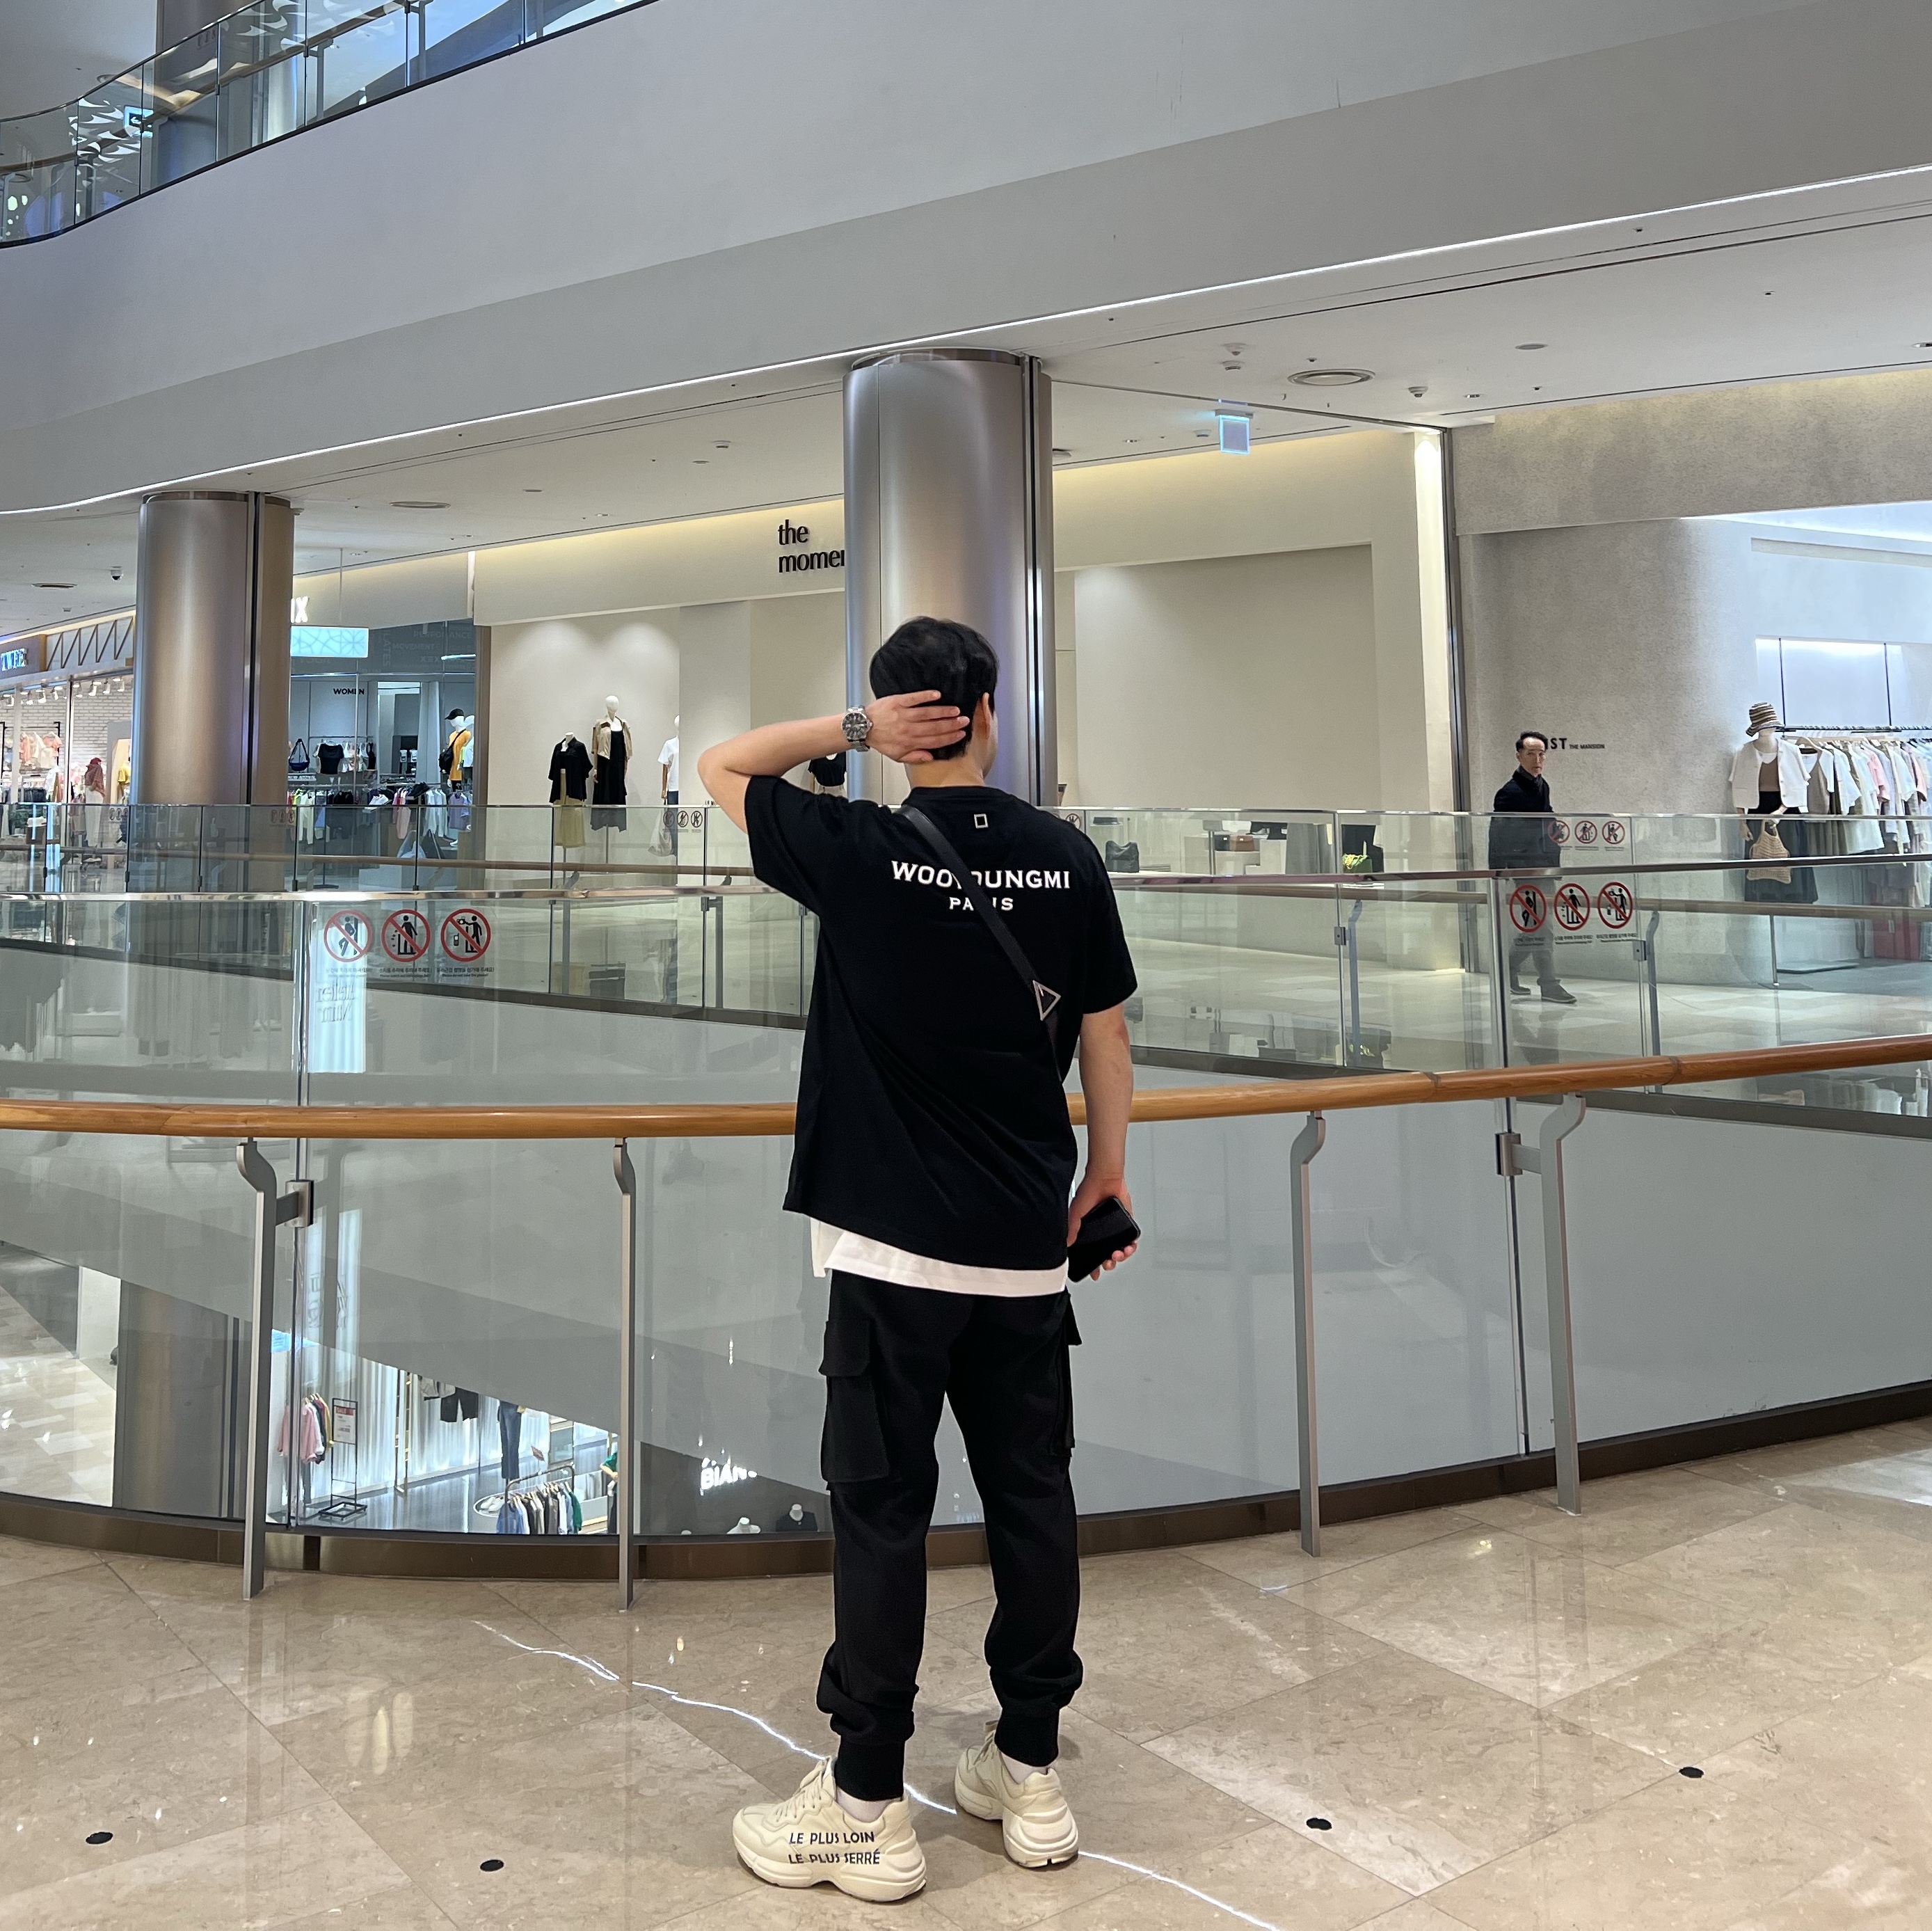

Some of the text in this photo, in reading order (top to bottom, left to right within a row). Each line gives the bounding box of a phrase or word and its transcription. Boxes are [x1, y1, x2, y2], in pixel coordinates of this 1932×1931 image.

[778, 519, 808, 545] the
[891, 860, 1070, 889] WOOUNGMI
[949, 896, 1014, 911] PAIS
[790, 1831, 875, 1844] LE PLUS LOIN
[788, 1848, 880, 1865] LE PLUS SERRÉ
